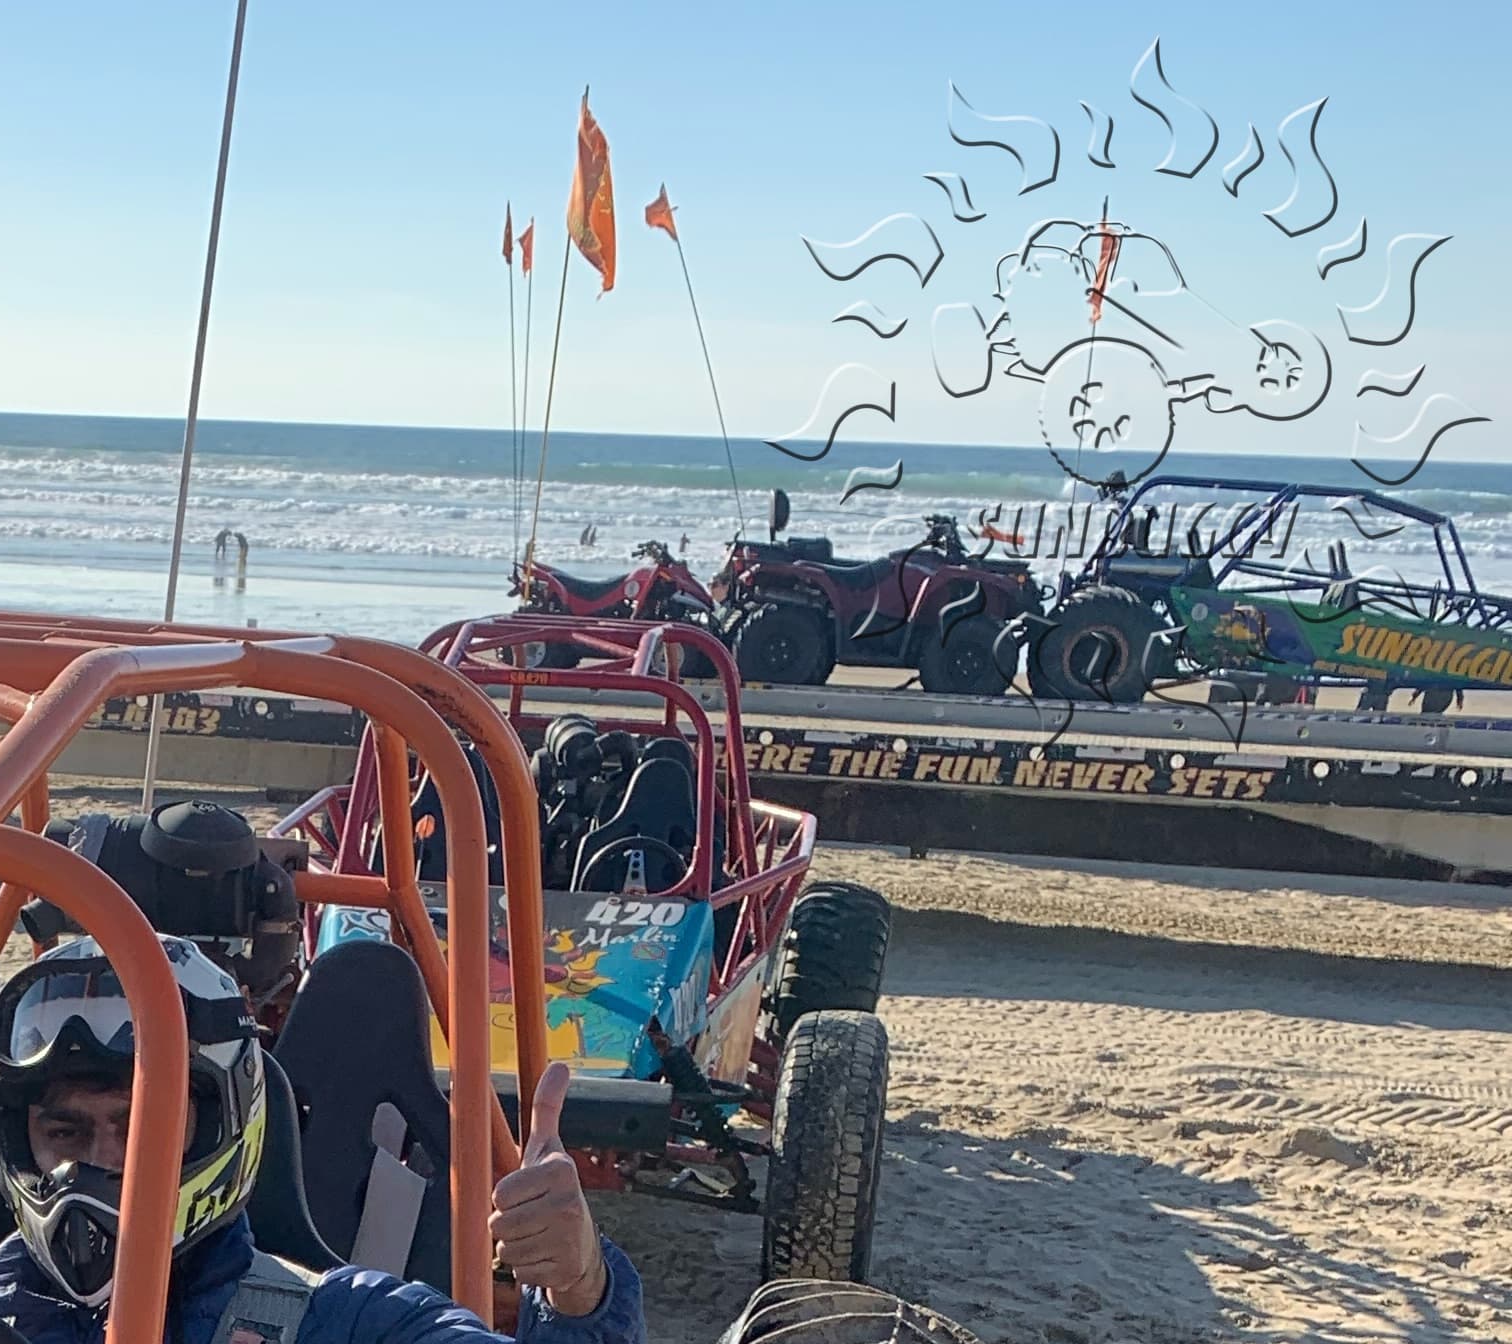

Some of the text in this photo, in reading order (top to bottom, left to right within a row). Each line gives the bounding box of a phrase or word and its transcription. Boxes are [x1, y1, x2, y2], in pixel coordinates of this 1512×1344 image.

[828, 748, 905, 779] THE
[914, 753, 1002, 784] FUN
[1014, 759, 1155, 794] NEVER
[1166, 767, 1275, 800] SETS
[585, 899, 686, 927] 420
[578, 926, 679, 948] Marlin
